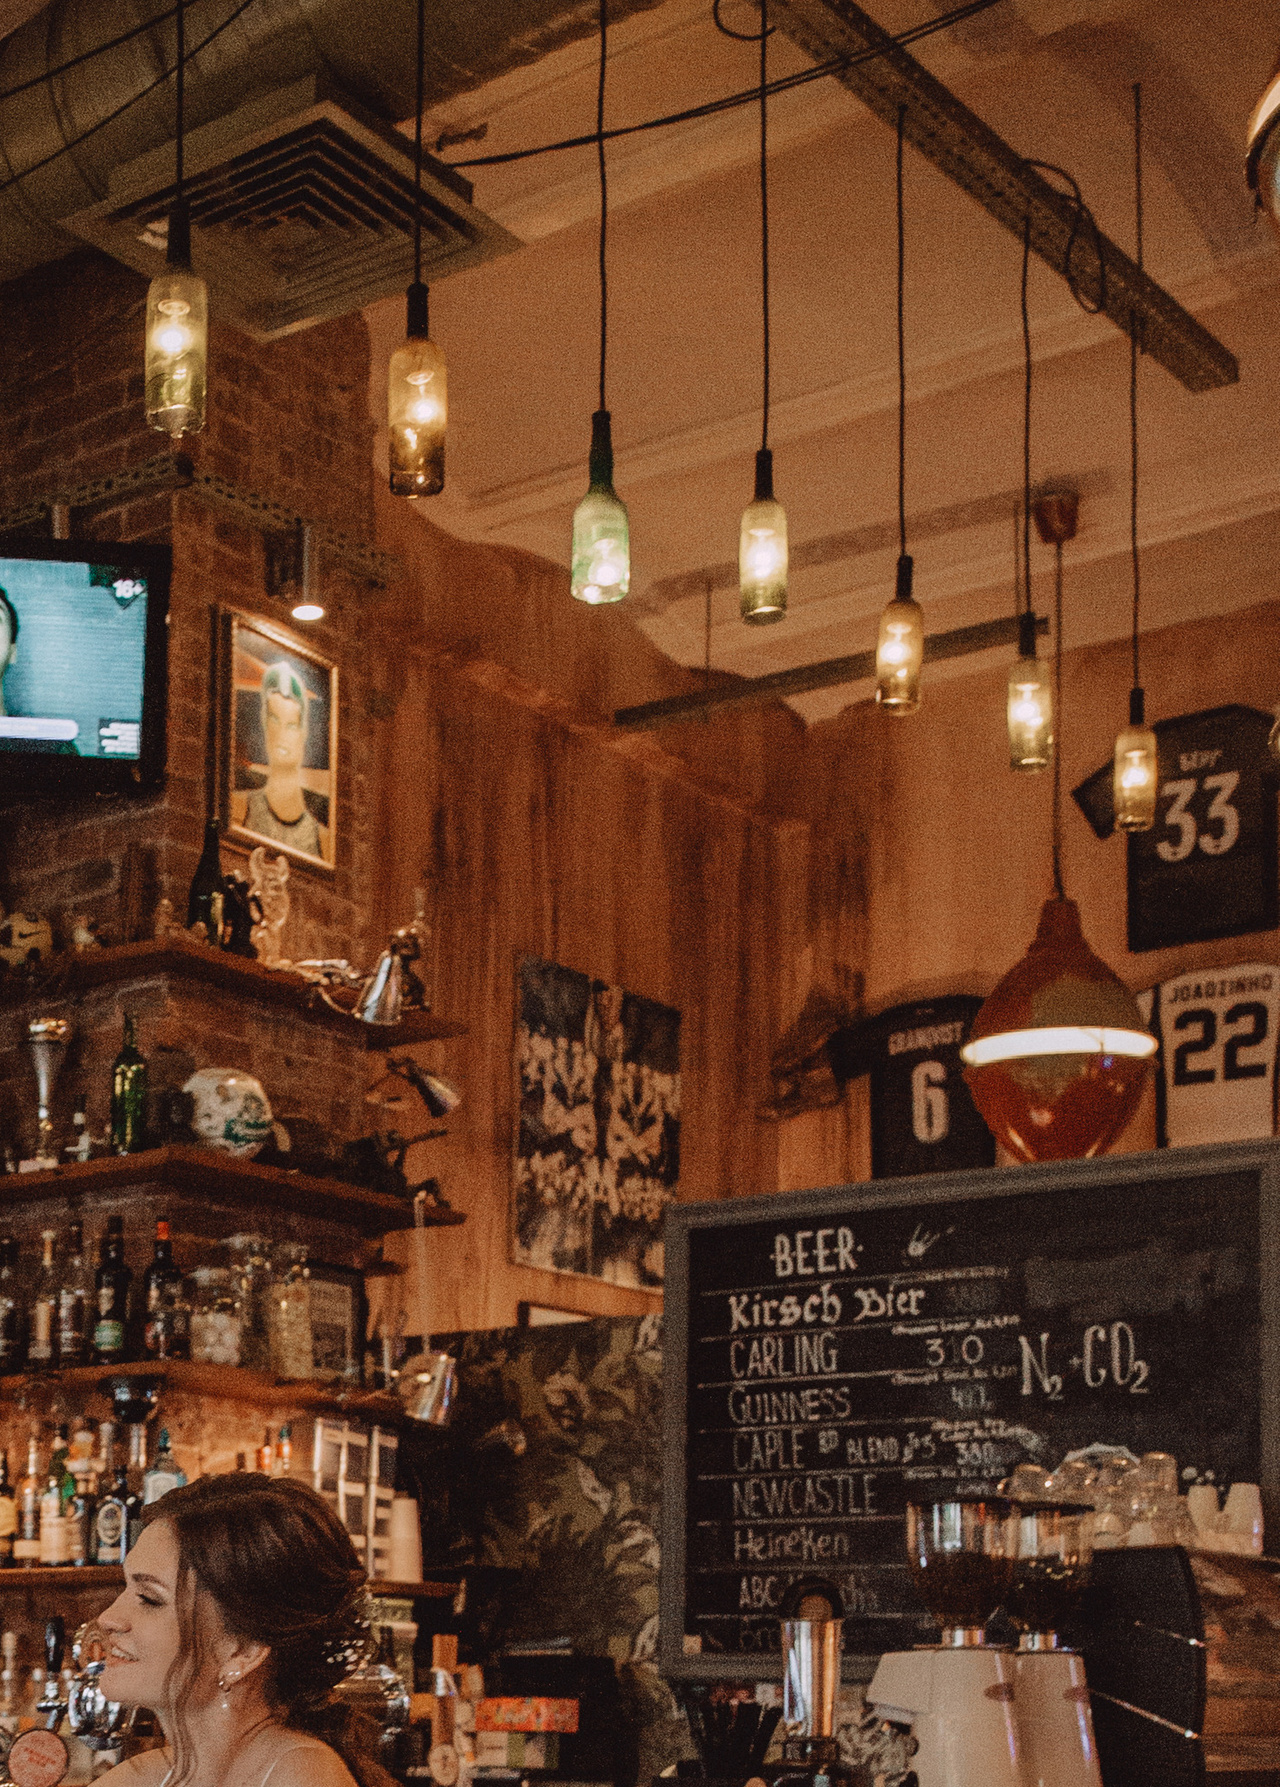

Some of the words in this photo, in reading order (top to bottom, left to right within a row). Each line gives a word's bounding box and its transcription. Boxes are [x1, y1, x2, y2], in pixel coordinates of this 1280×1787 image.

[1156, 770, 1241, 863] 33
[1169, 973, 1274, 1004] JOAOZINHO
[1173, 1001, 1269, 1087] 22
[910, 1059, 950, 1144] 6
[774, 1226, 859, 1278] BEER
[729, 1332, 839, 1380] CARLING
[728, 1383, 852, 1426] GUINNESS
[732, 1428, 805, 1472] CAPLE
[732, 1474, 878, 1519] NEWCASTLE
